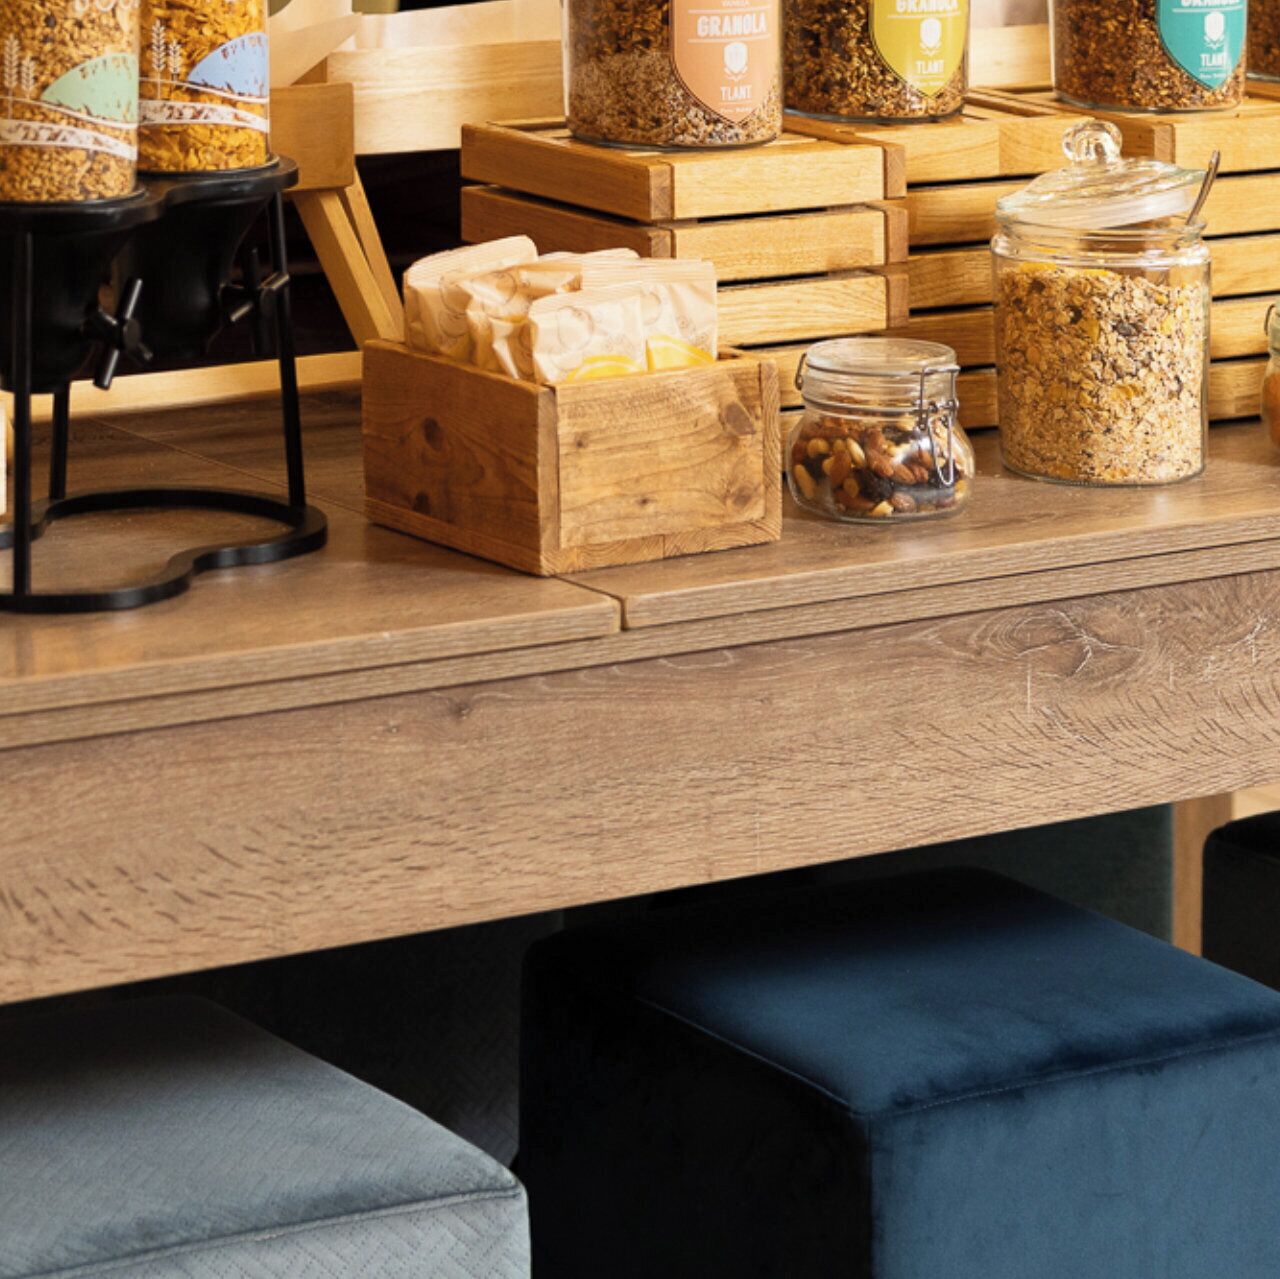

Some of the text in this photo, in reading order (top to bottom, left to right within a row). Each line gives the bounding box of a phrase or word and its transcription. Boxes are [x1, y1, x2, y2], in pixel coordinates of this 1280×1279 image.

[697, 12, 767, 38] GRANOLA
[915, 59, 945, 74] TLANT
[720, 85, 752, 101] TLANT
